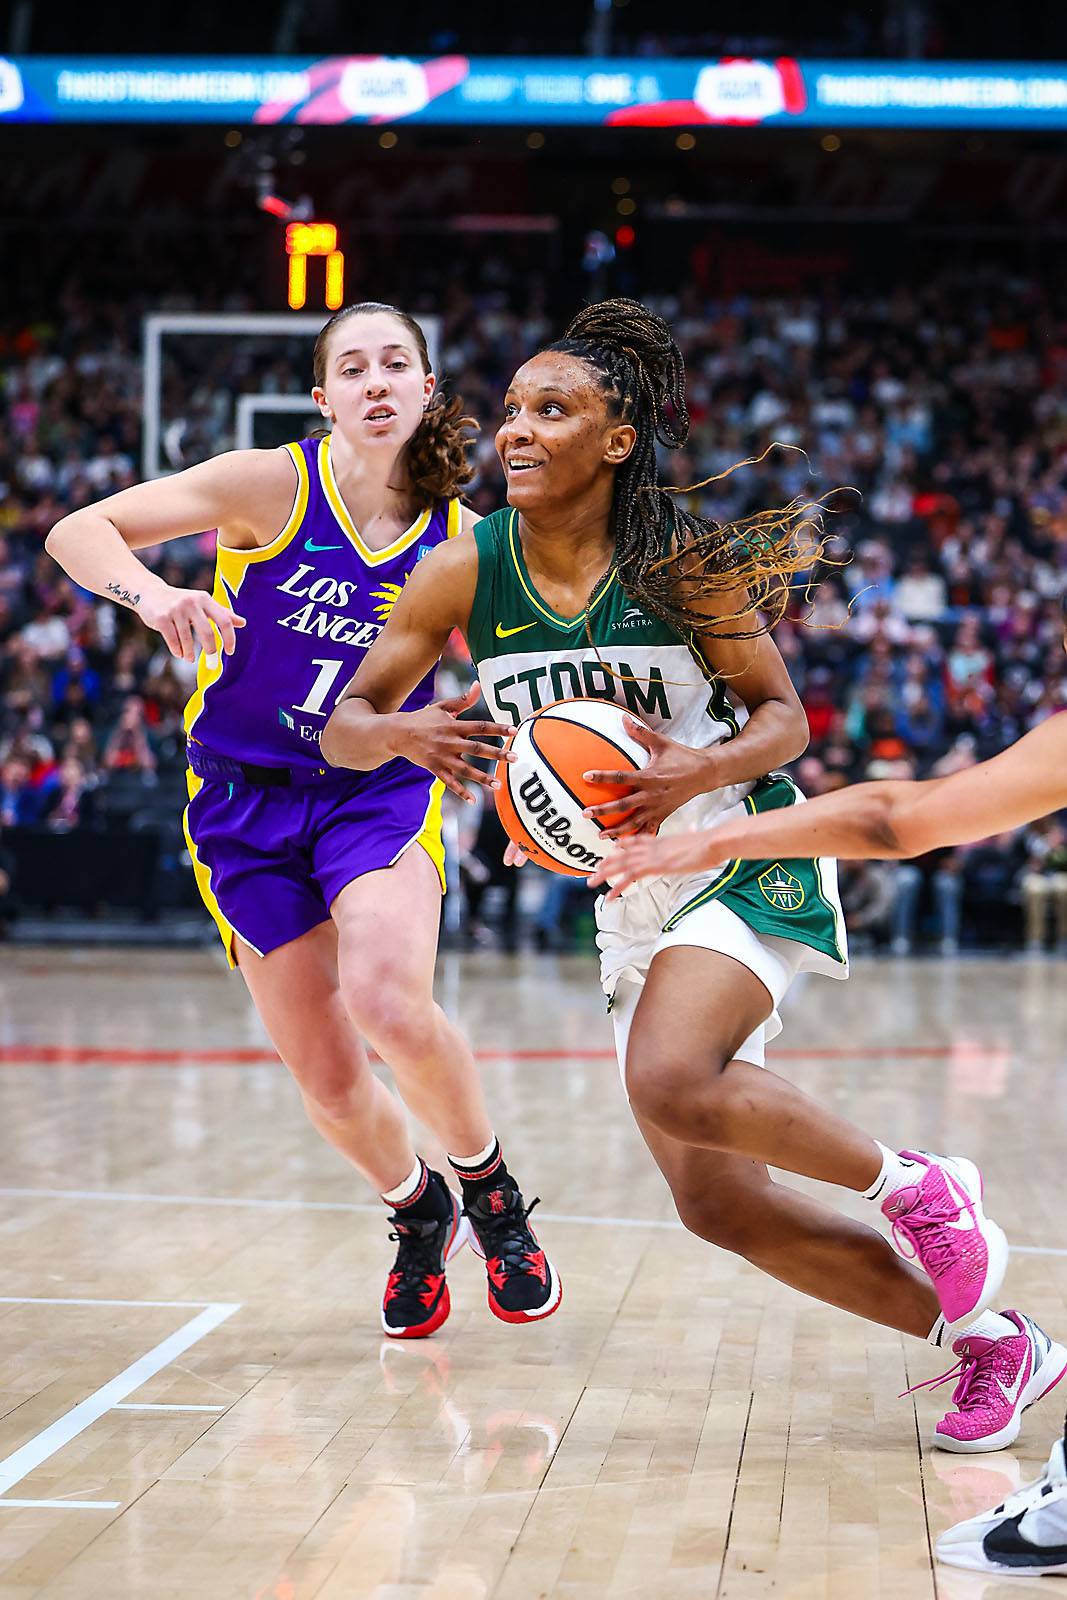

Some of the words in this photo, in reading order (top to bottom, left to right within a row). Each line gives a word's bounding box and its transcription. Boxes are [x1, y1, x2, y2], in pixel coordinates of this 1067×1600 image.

[276, 563, 358, 607] LOS
[276, 602, 385, 649] ANGE
[611, 619, 653, 630] SYMETRA
[291, 658, 355, 717] 1
[494, 661, 672, 726] STORM
[299, 725, 323, 746] Eq
[519, 769, 604, 868] Wilson
